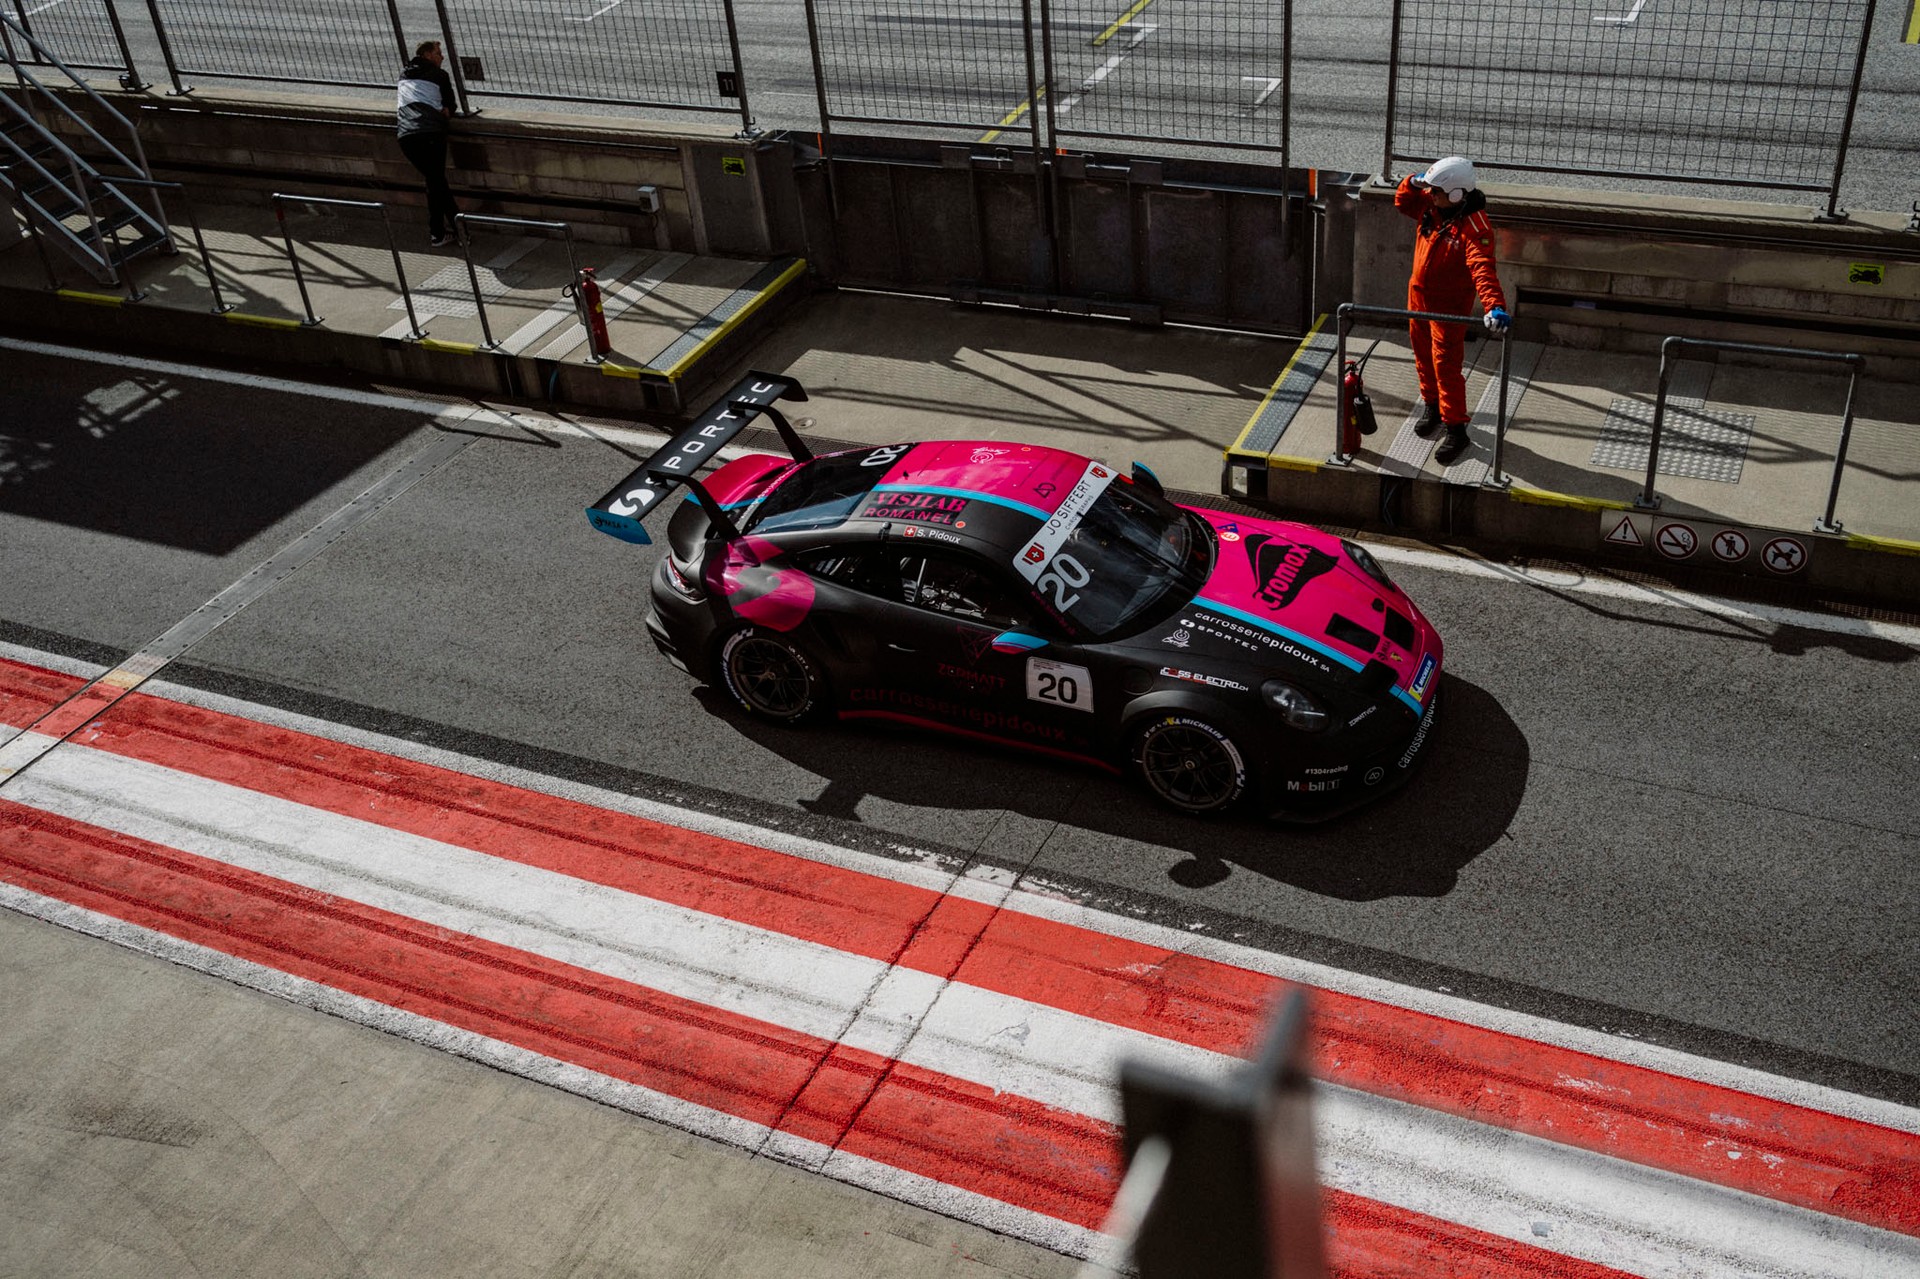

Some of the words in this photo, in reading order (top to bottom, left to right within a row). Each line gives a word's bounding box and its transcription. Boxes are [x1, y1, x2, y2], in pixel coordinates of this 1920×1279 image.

[722, 78, 735, 92] 11
[860, 445, 909, 467] 20
[877, 493, 968, 513] VISILAB
[1046, 518, 1062, 536] JO
[1057, 480, 1091, 519] SIFFERT
[863, 507, 957, 526] ROMANEL
[917, 529, 927, 538] S.
[929, 530, 962, 545] Pidoux
[1037, 553, 1090, 613] 20
[1195, 612, 1320, 666] carrosseriepidoux
[1320, 663, 1331, 673] SA
[1197, 625, 1258, 652] SPORTEC
[1038, 673, 1077, 704] 20
[1181, 717, 1224, 740] MICHELIN
[1304, 764, 1349, 775] #1304racing
[1287, 779, 1325, 792] Mobil
